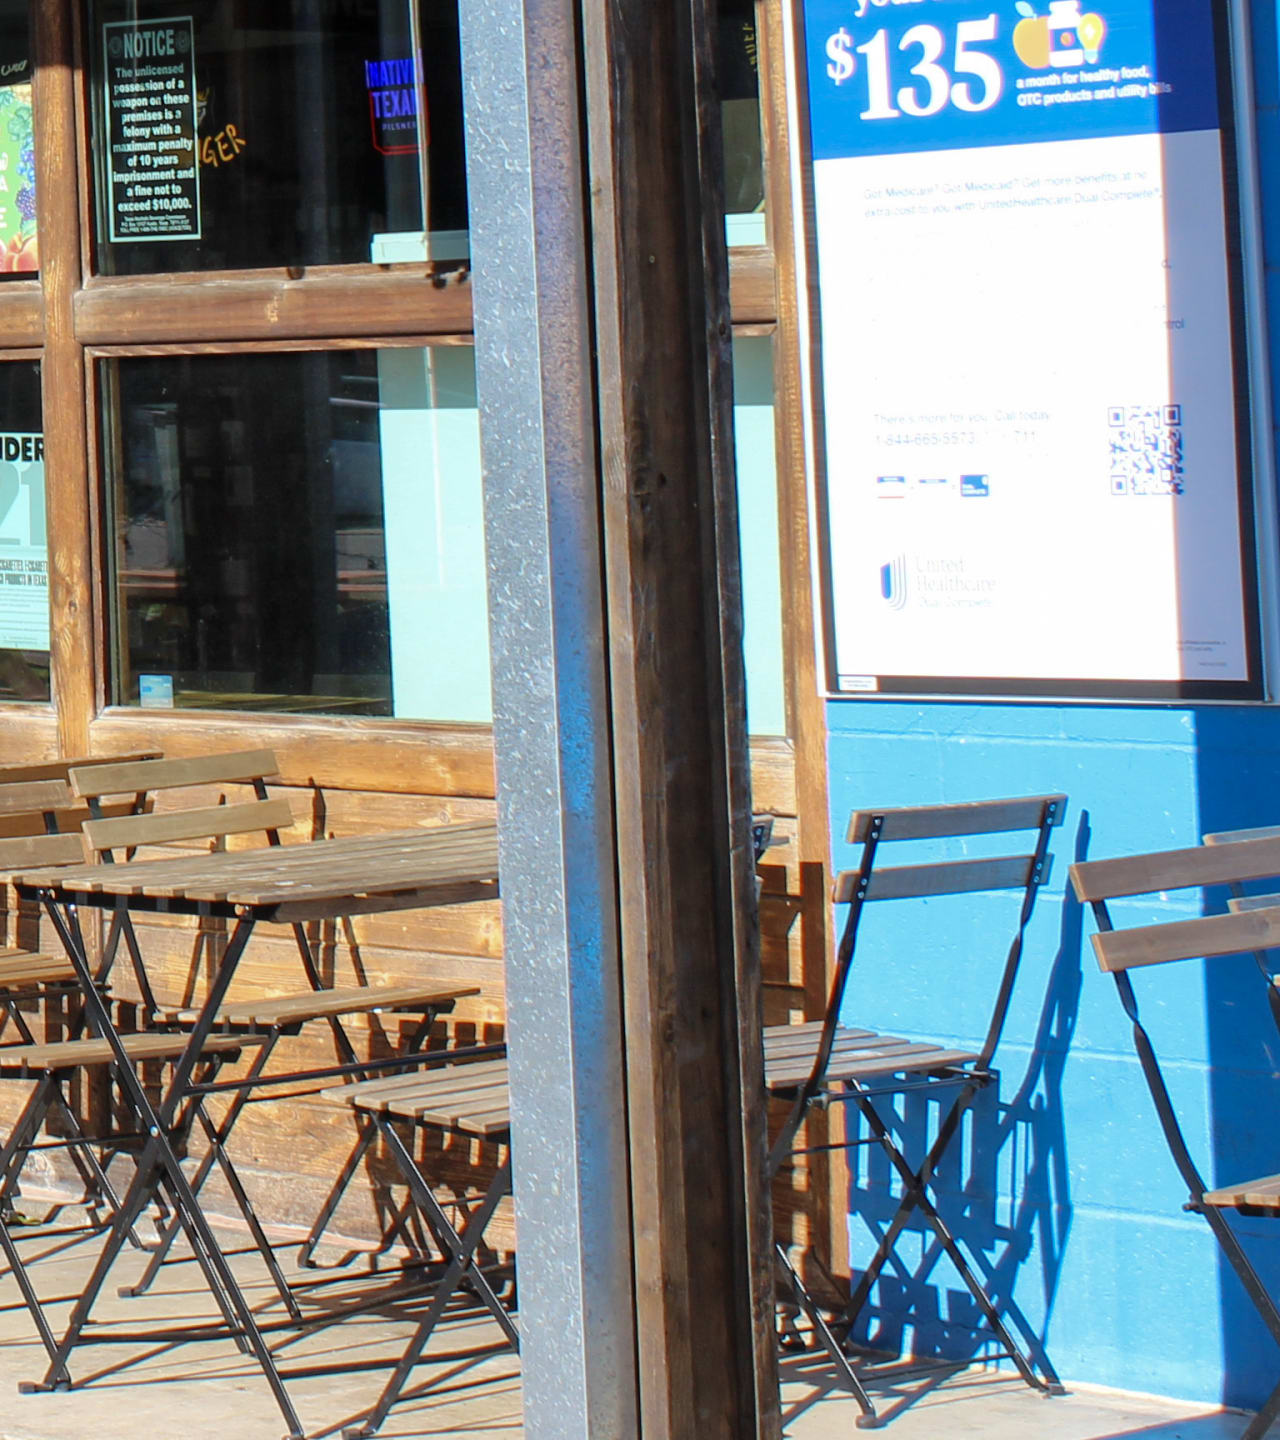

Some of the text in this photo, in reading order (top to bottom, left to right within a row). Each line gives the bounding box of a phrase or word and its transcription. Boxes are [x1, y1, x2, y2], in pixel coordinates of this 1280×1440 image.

[123, 28, 175, 59] NOTICE
[115, 62, 184, 78] The unlicensed
[368, 57, 416, 88] NATIV
[825, 13, 1002, 120] $135
[114, 78, 185, 96] possession of a
[1016, 78, 1025, 89] a
[1025, 74, 1061, 88] month
[1062, 72, 1079, 84] for
[1079, 69, 1120, 82] healthy
[112, 93, 190, 110] weapon on these
[1017, 82, 1172, 106] OTC products and utility bills
[121, 108, 182, 125] premises is a
[122, 123, 182, 139] felony with a
[113, 137, 193, 153] maximum penalty
[201, 123, 247, 168] GER
[127, 154, 179, 168] of 10 years
[113, 167, 195, 184] imprisonment and
[126, 183, 182, 197] a fine not to
[118, 197, 192, 212] exceed $10,000.
